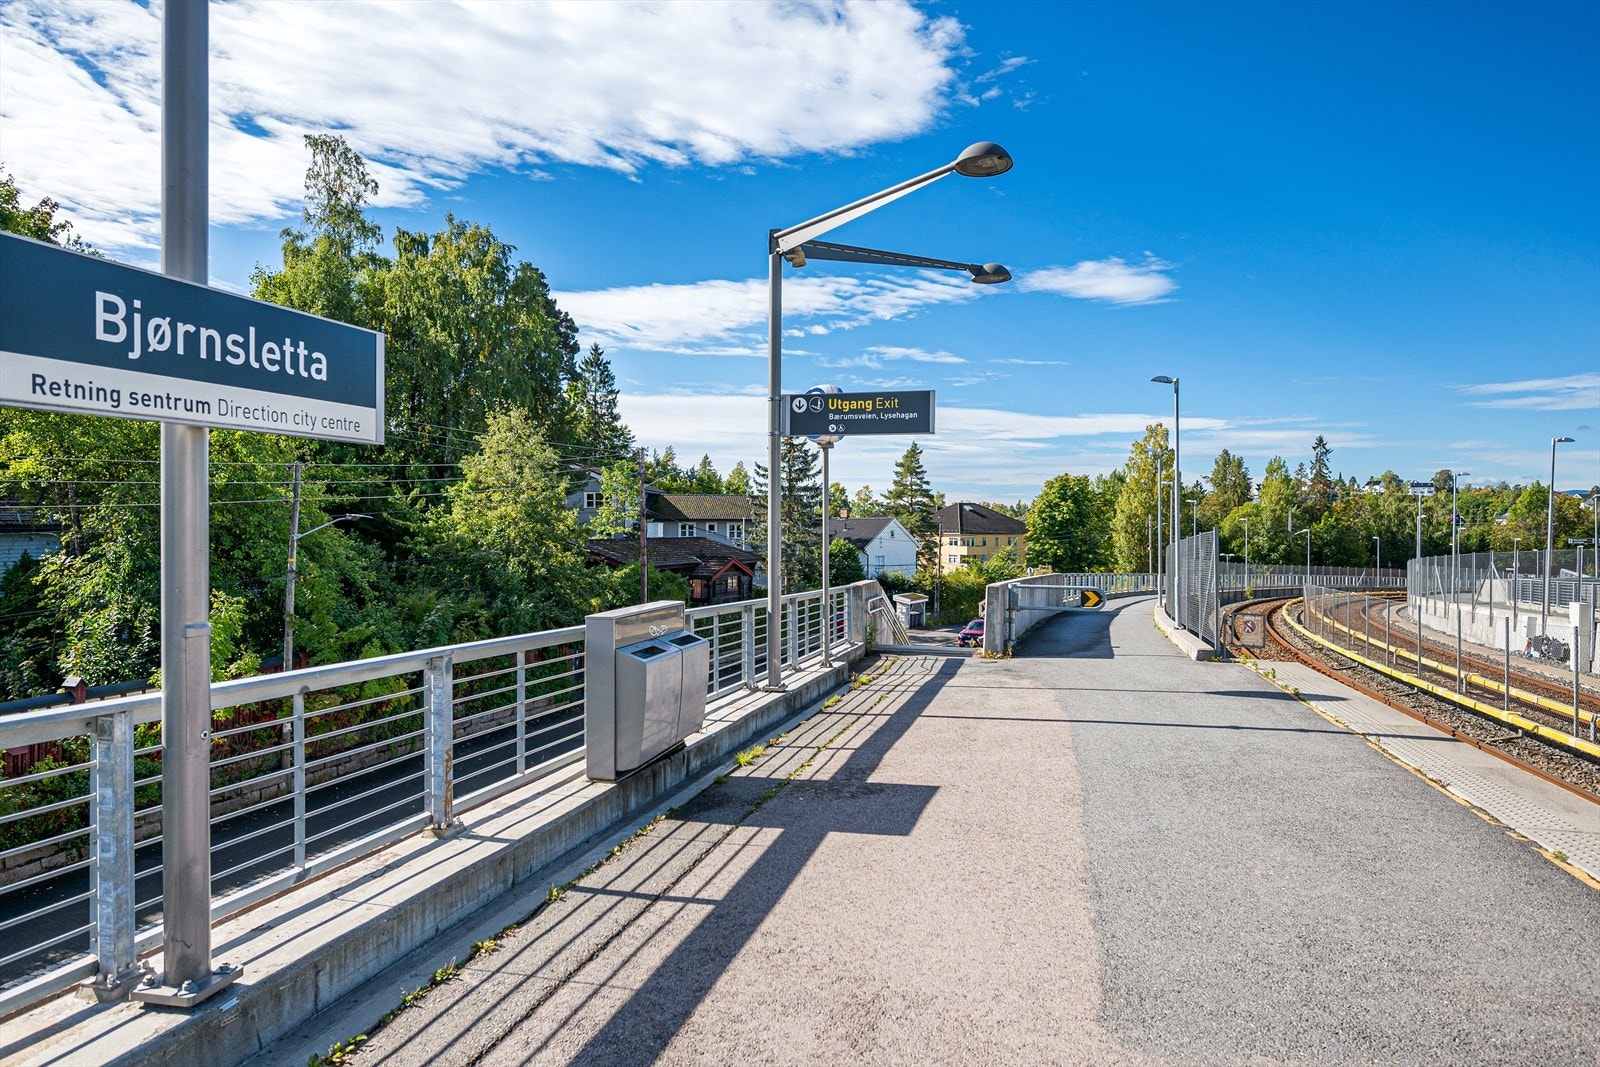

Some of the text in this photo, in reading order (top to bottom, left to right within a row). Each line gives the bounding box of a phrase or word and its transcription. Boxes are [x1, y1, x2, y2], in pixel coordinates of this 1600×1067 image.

[95, 291, 328, 382] Bjørnsletta
[31, 373, 361, 433] Retning sentrum Direction city centre
[828, 397, 899, 411] Utgang Exit
[880, 412, 918, 420] Lysehagan
